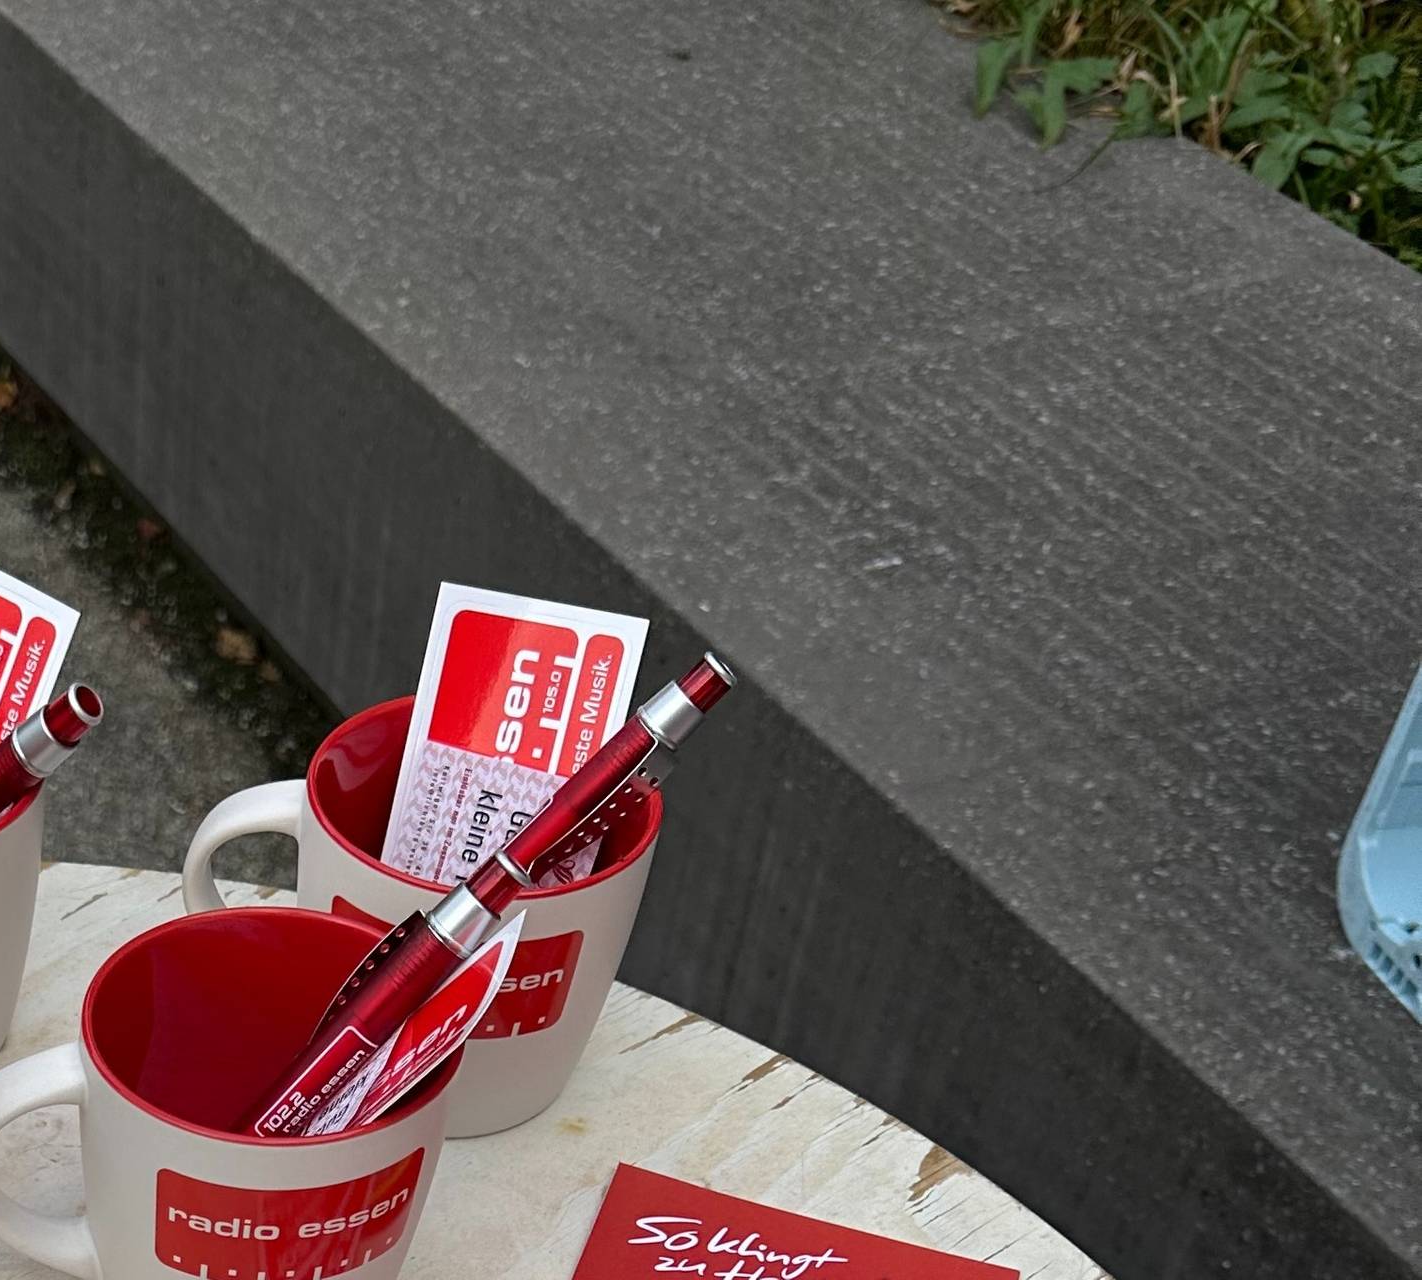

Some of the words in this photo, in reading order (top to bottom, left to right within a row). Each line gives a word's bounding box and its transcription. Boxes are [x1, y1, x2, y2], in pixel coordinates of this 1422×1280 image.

[10, 639, 46, 706] Musik.
[542, 670, 563, 714] 105.0
[579, 654, 613, 724] Musik.
[495, 649, 541, 764] sen
[461, 789, 503, 864] kleine
[263, 1091, 306, 1133] 102.2
[282, 1094, 321, 1134] radio
[321, 1049, 366, 1094] essen
[168, 1206, 280, 1241] radio
[298, 1187, 409, 1239] essen
[627, 1216, 703, 1251] So
[707, 1227, 849, 1279] klingt
[654, 1256, 707, 1276] zu
